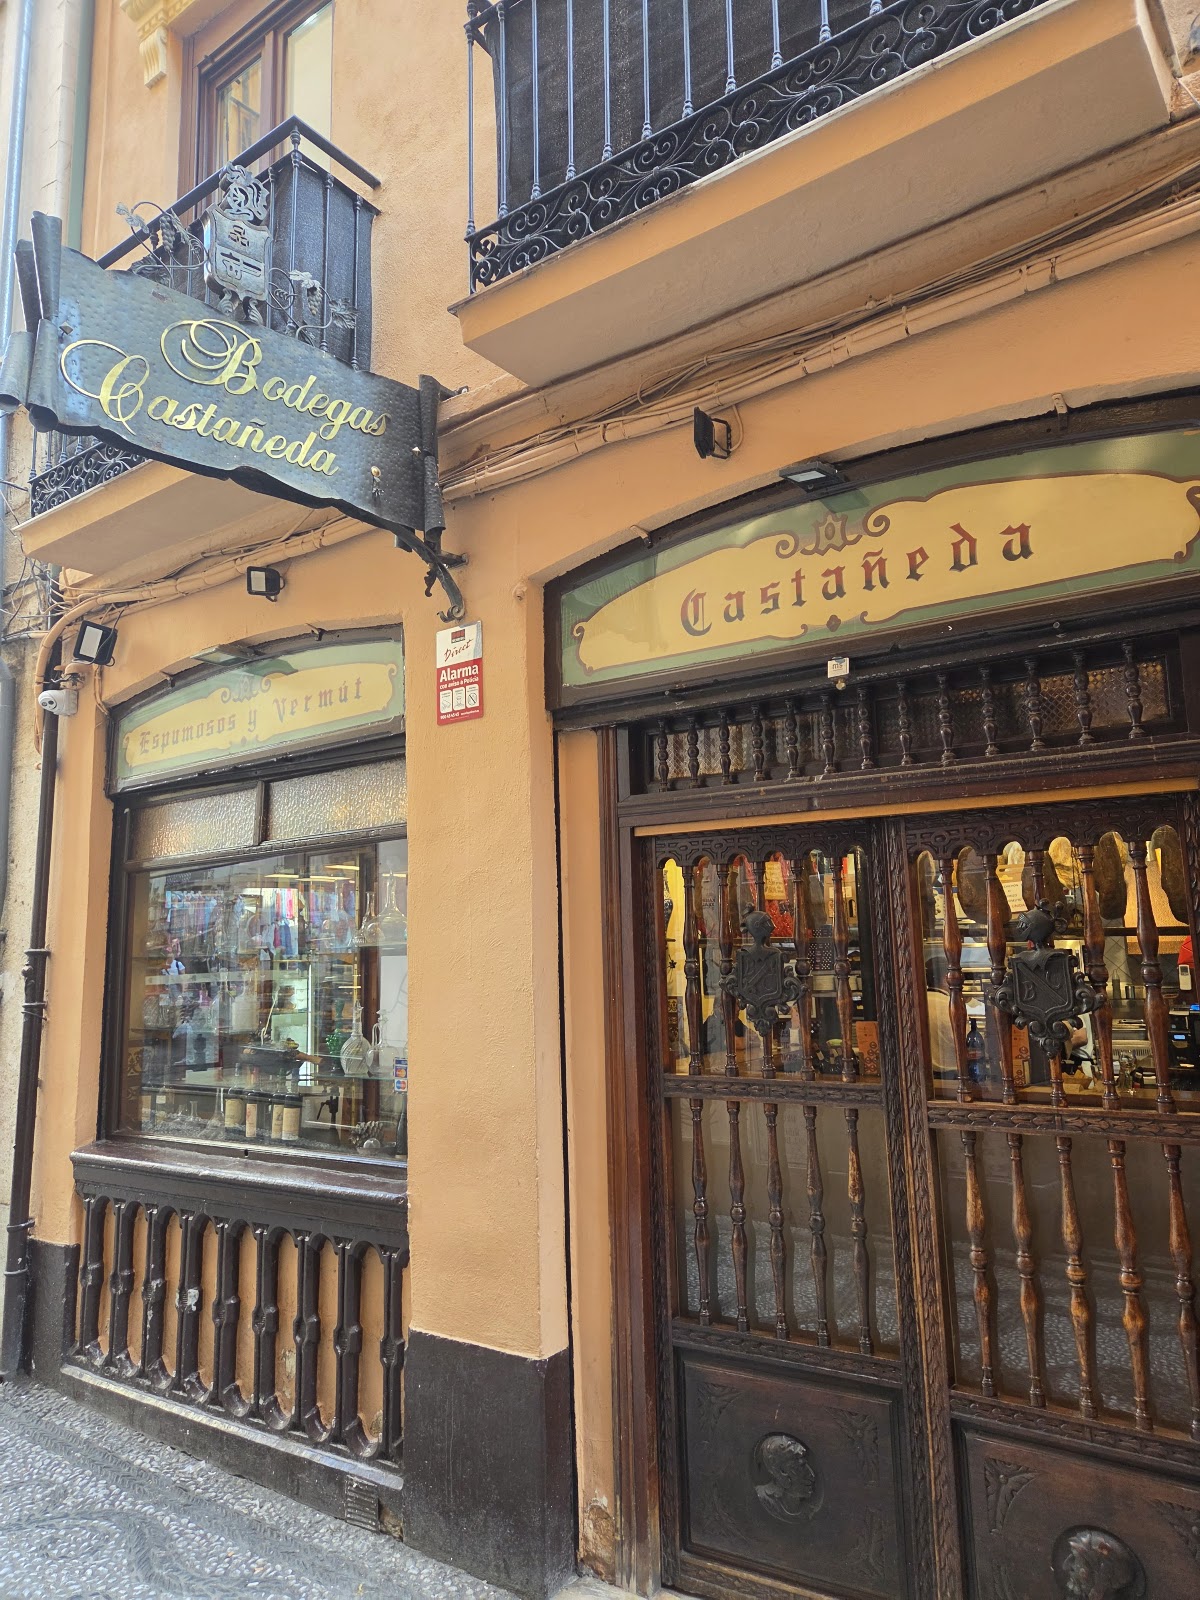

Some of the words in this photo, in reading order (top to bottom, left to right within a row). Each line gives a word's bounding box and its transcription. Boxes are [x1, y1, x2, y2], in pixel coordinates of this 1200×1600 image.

[60, 339, 339, 476] Castañeda
[161, 319, 392, 440] Bodegas
[681, 522, 1035, 637] Castañeda
[440, 664, 479, 682] Alarma
[444, 638, 473, 662] Direct
[139, 712, 237, 755] Espumosos
[246, 708, 258, 733] y
[272, 676, 363, 724] Vermút
